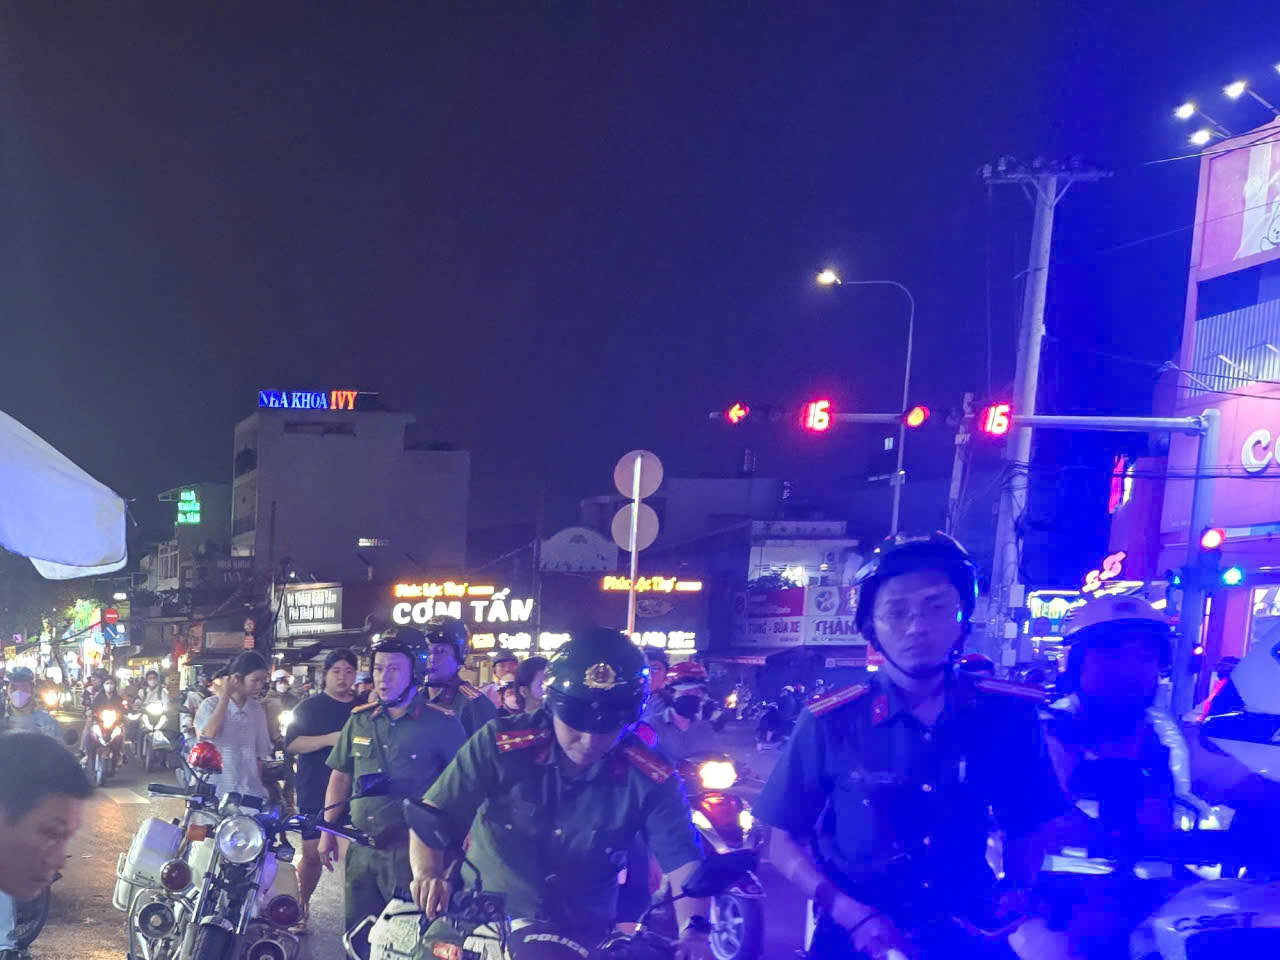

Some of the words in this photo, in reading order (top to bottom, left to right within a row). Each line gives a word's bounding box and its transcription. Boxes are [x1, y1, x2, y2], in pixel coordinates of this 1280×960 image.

[291, 391, 328, 409] KHOA
[329, 390, 358, 410] IVY
[807, 400, 830, 431] 16
[986, 404, 1009, 434] 16
[392, 597, 462, 624] CƠM
[523, 933, 589, 958] POLICE
